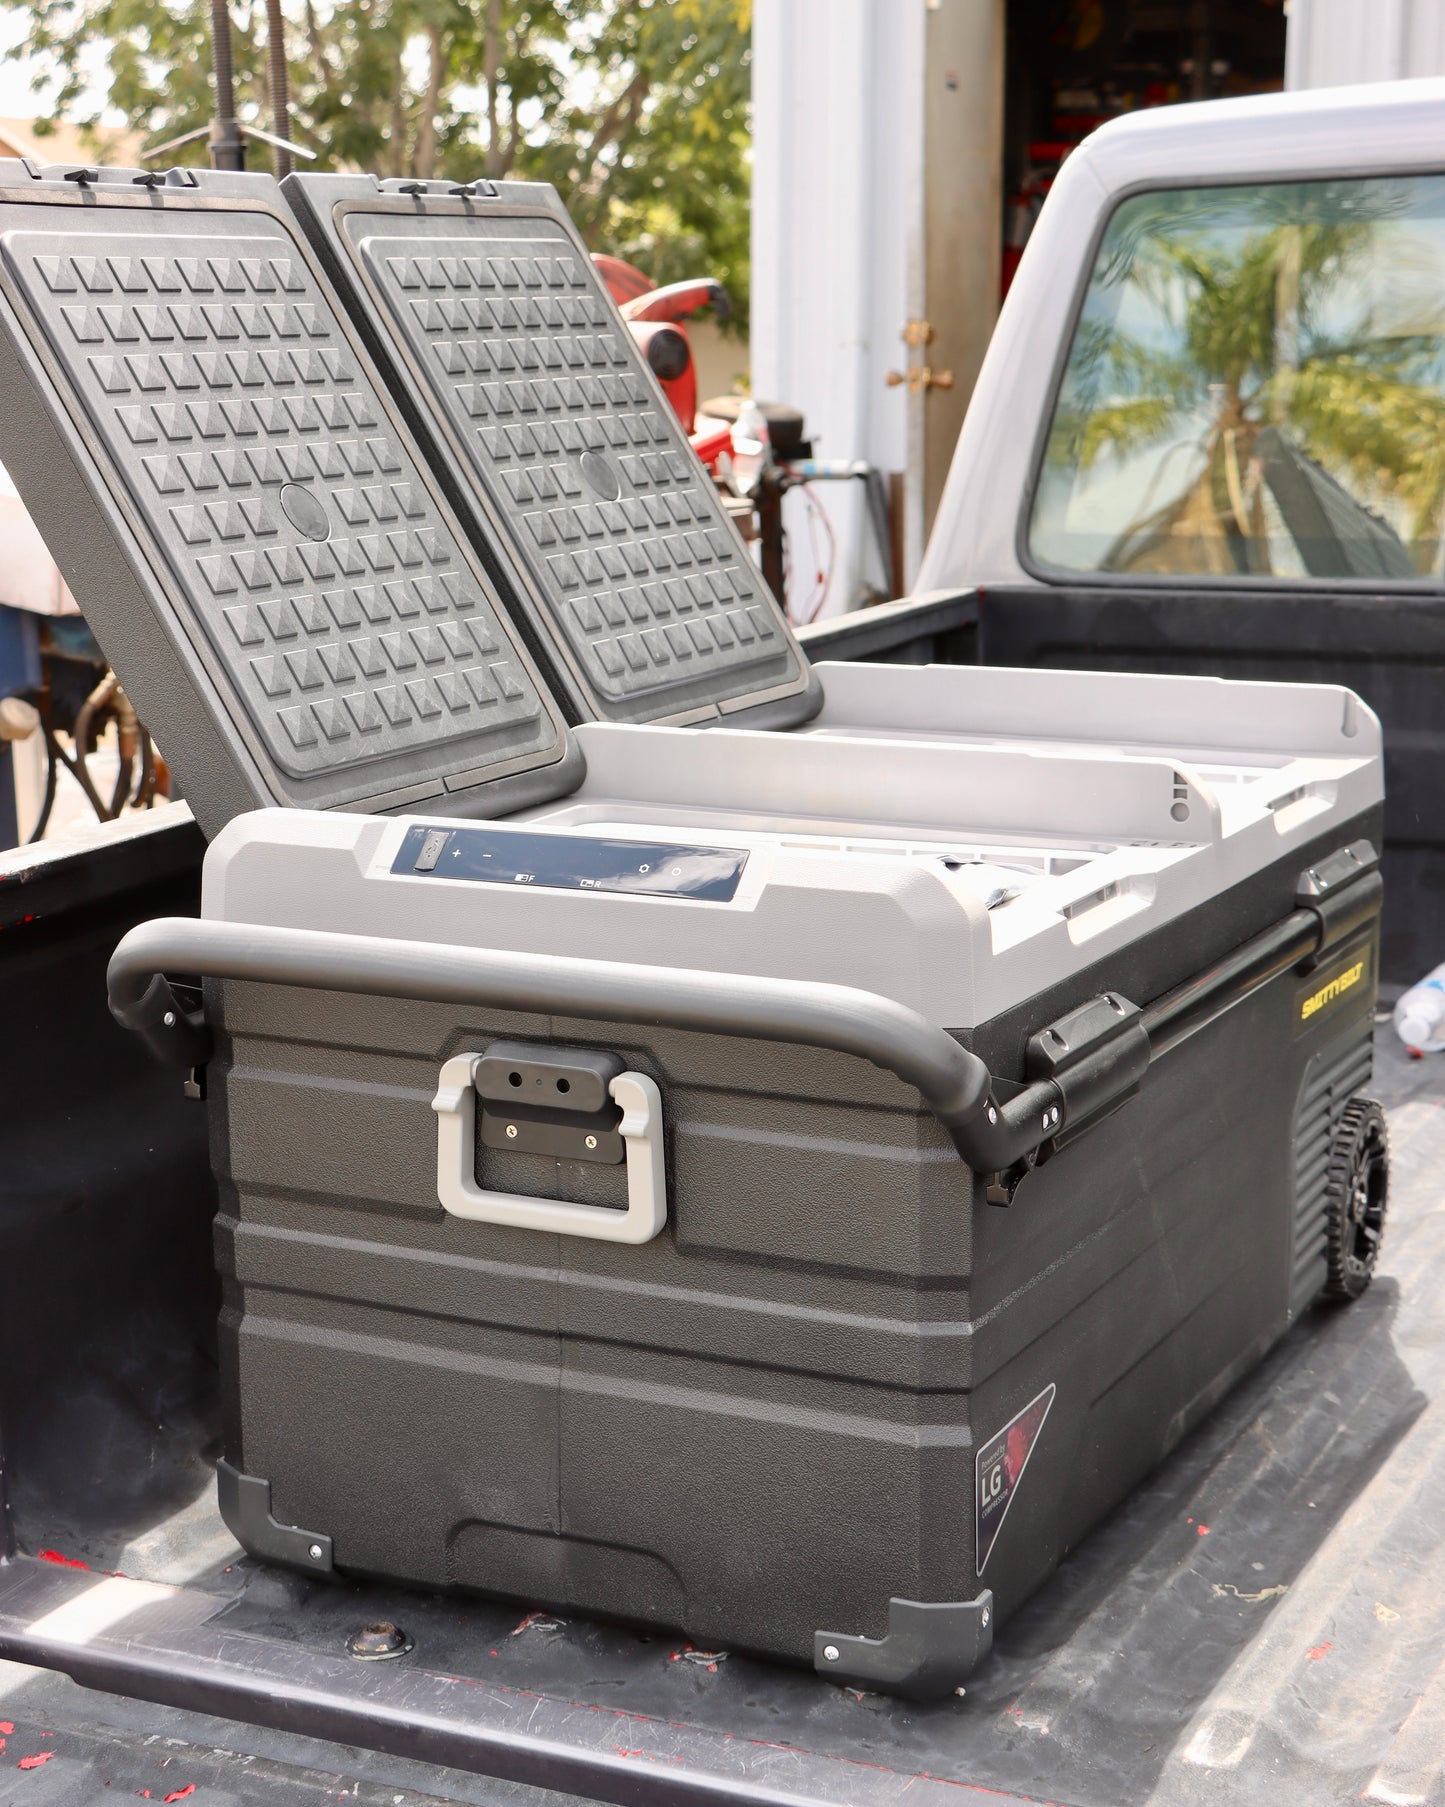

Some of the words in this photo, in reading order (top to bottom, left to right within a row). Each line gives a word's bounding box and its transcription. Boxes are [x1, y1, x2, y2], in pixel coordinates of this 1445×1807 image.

[594, 880, 602, 888] R
[982, 1447, 1000, 1470] Powered
[982, 1464, 1001, 1507] LG
[982, 1488, 1009, 1519] COMPRESSOR
